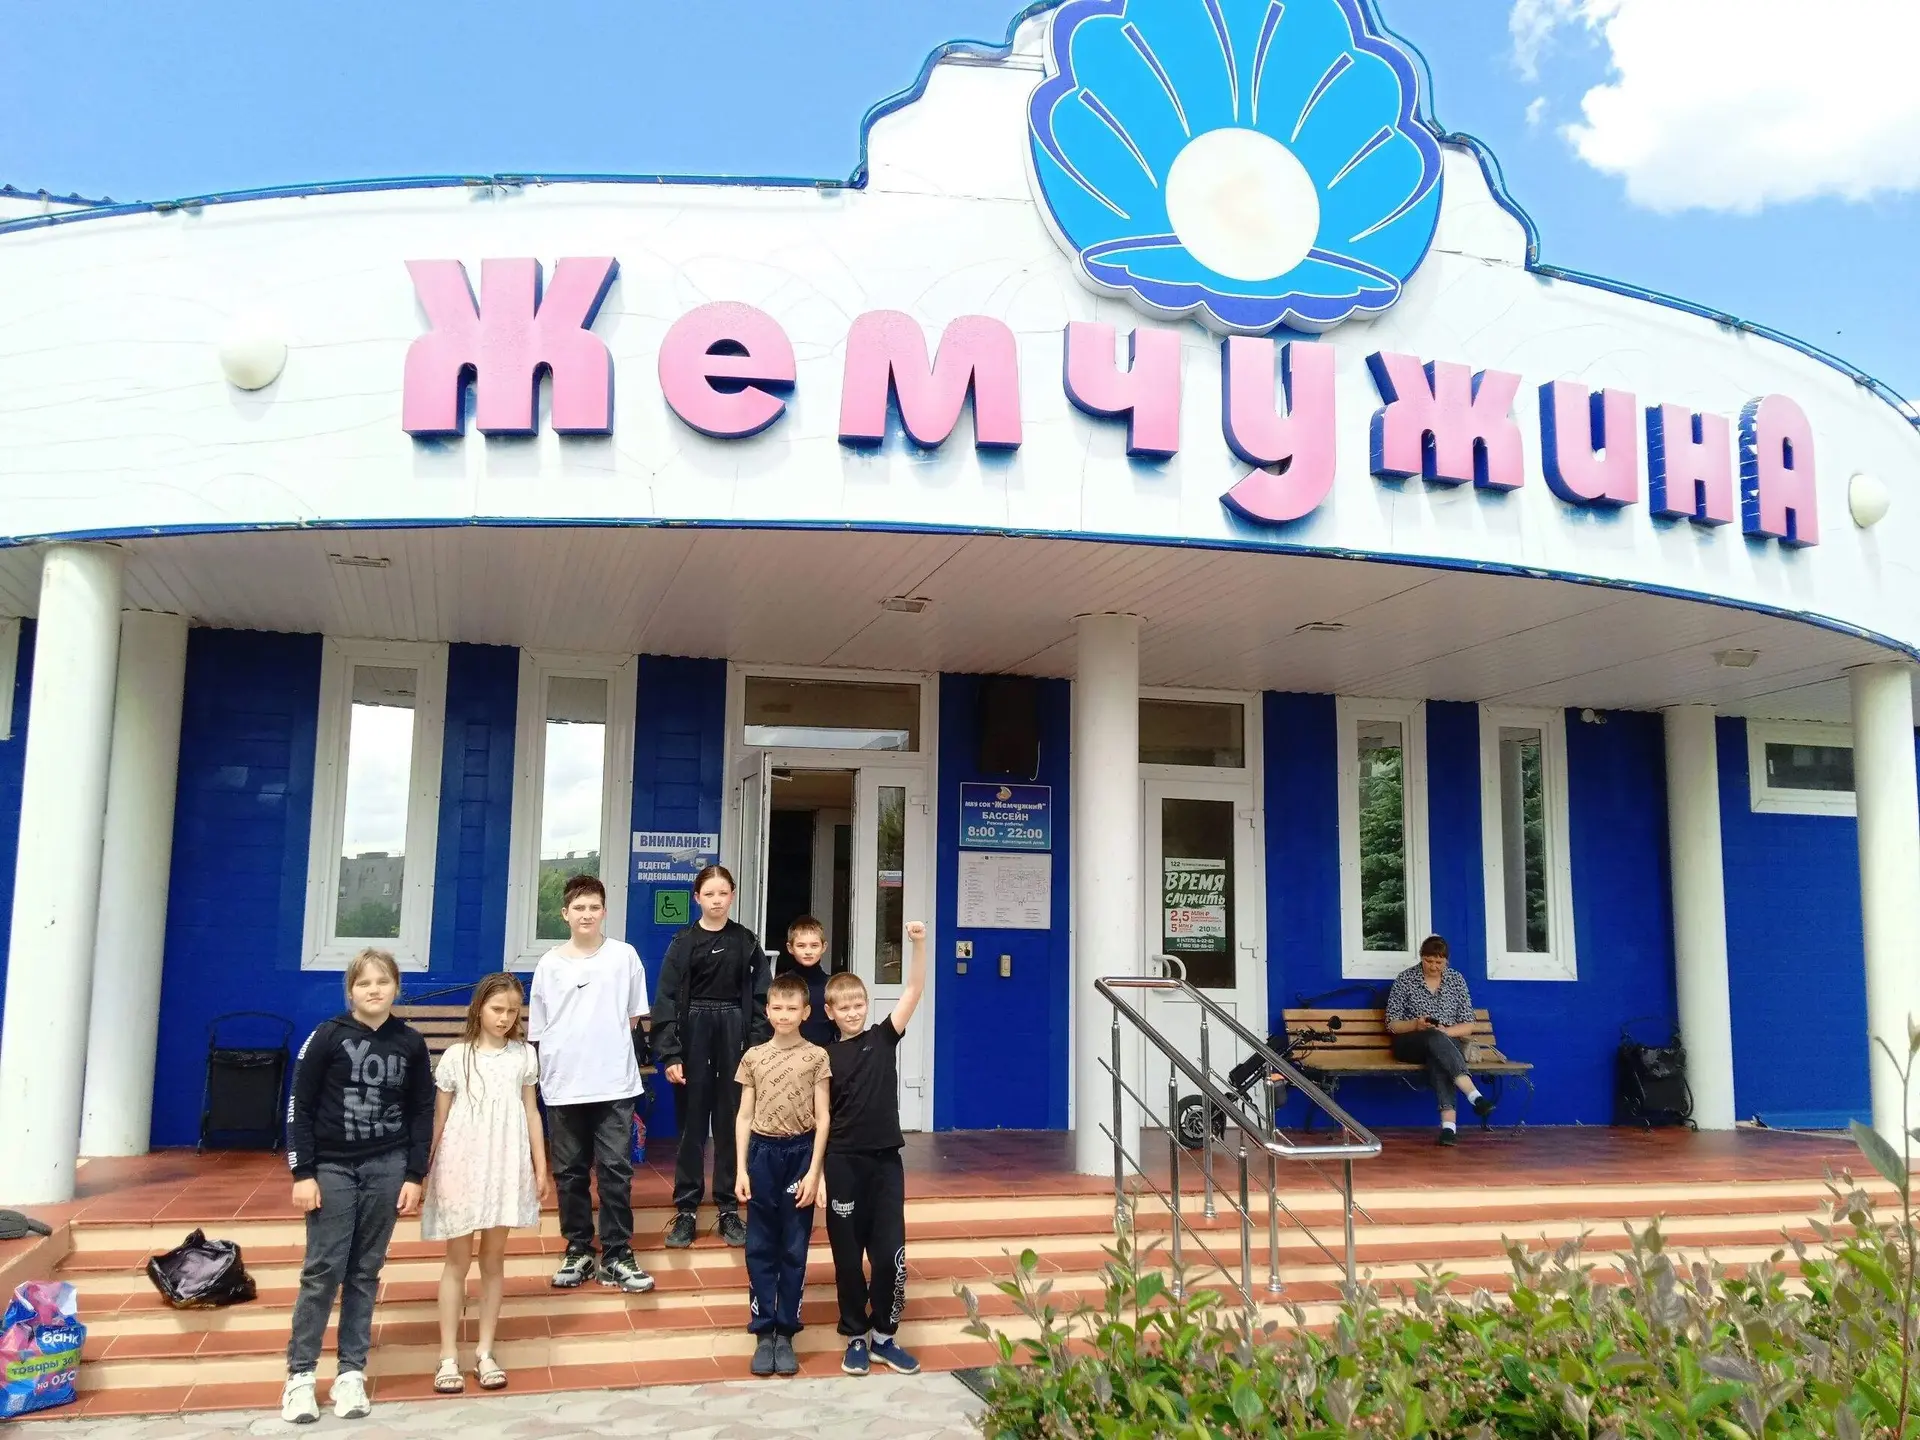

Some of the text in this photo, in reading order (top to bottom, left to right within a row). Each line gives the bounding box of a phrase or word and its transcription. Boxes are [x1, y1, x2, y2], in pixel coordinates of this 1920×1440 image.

[982, 811, 1029, 821] БАССЕЙН
[968, 826, 995, 837] 8:00
[1007, 828, 1043, 839] 22:00
[640, 835, 711, 848] ВНИМАНИЕ!
[638, 861, 671, 870] ВЕДЕТСЯ
[1165, 872, 1225, 891] ВРЕМЯ
[1170, 910, 1190, 923] 2,5
[1171, 924, 1177, 932] 5
[769, 1066, 794, 1087] Jeans
[12, 1360, 59, 1375] товары
